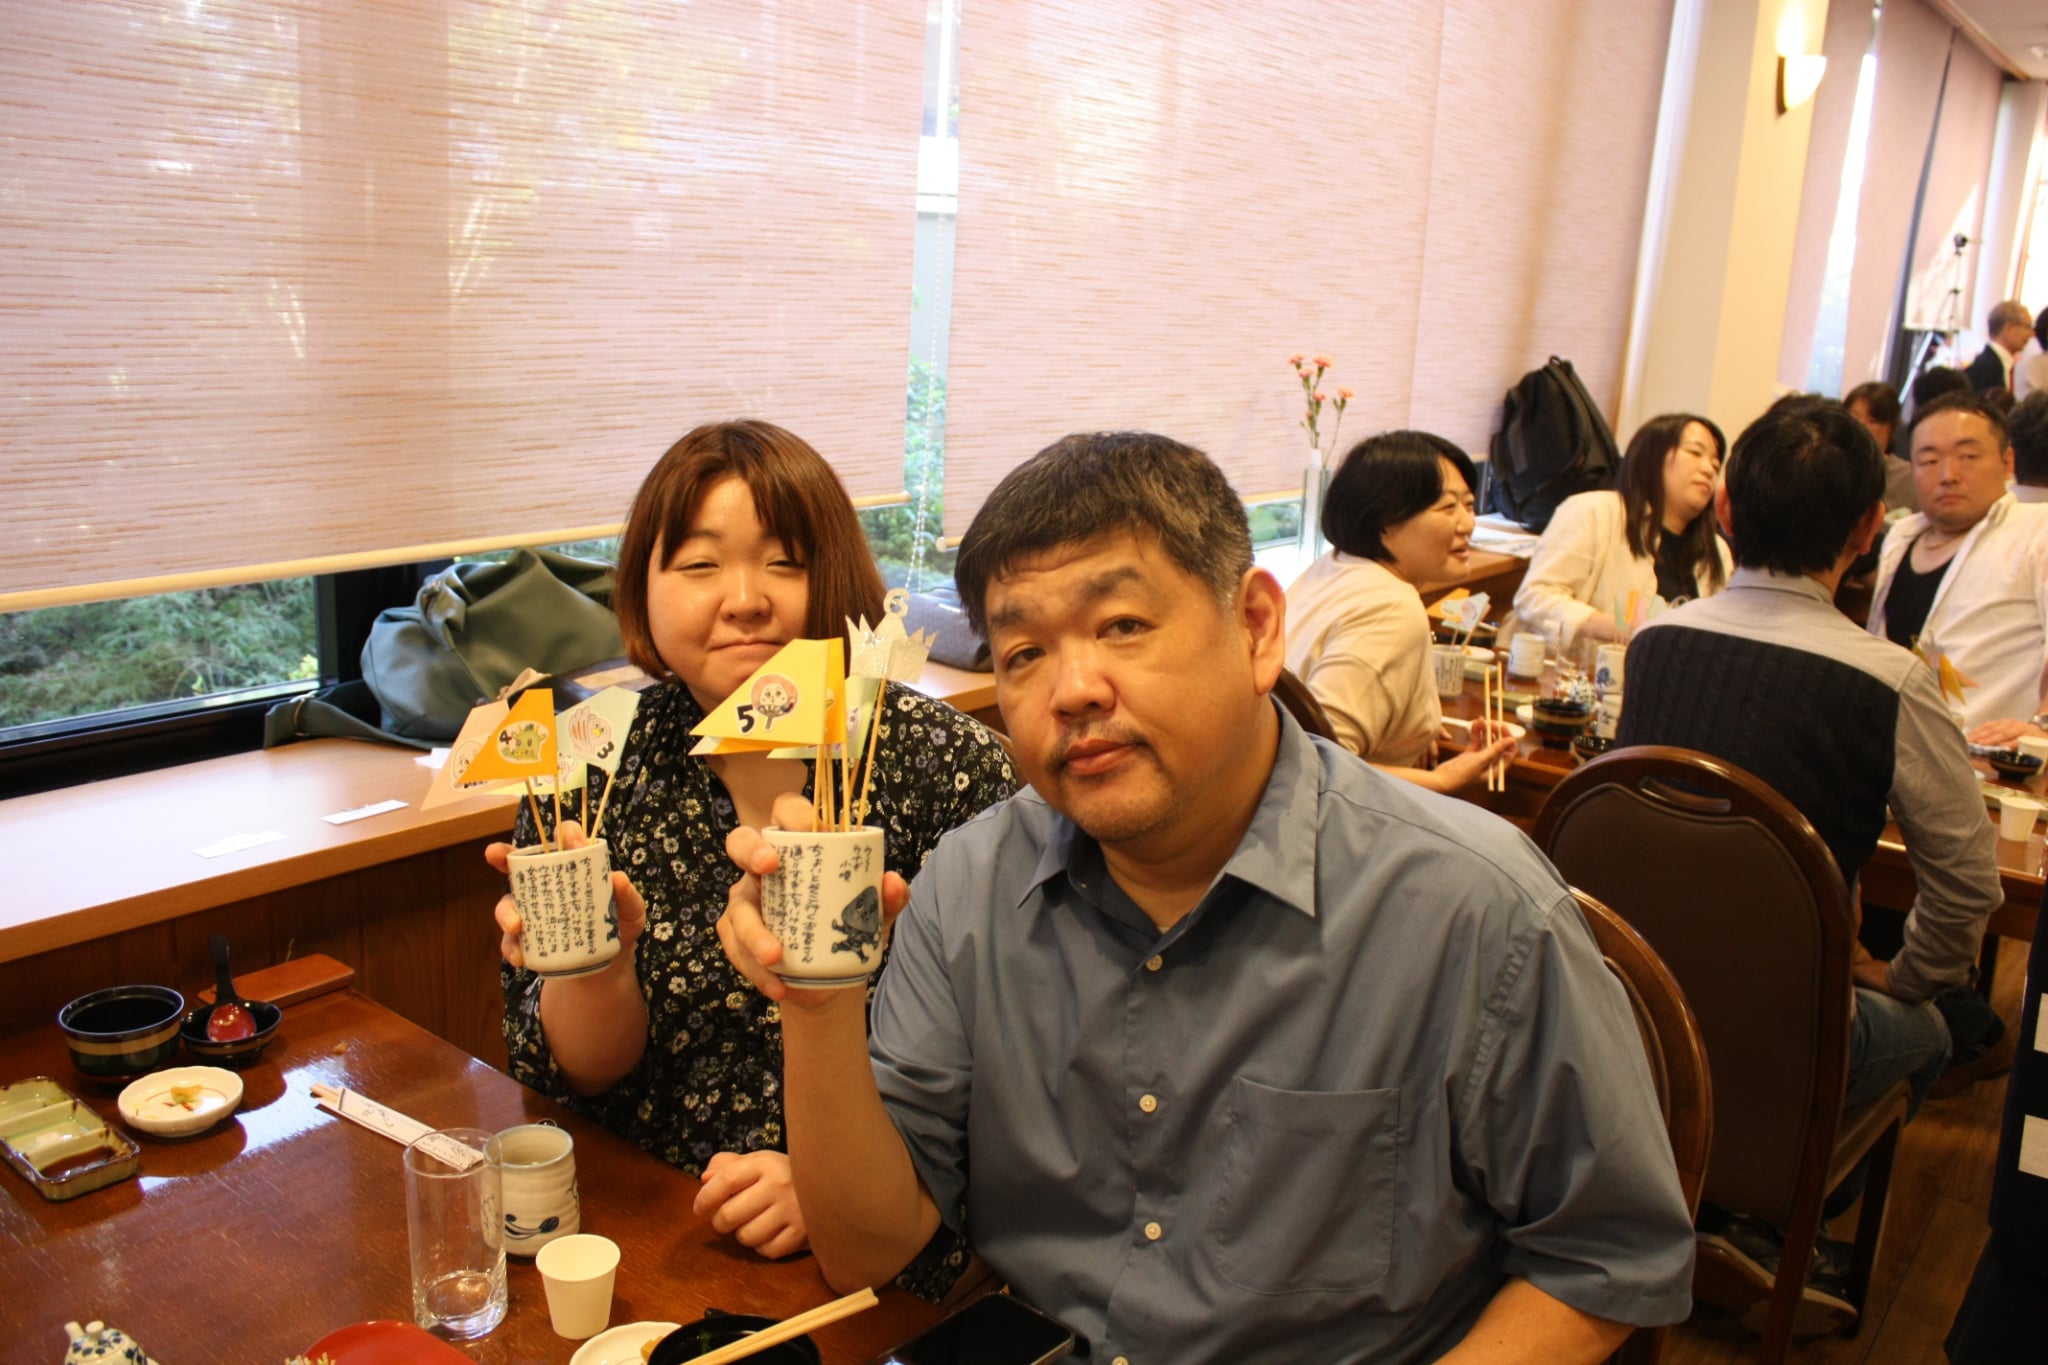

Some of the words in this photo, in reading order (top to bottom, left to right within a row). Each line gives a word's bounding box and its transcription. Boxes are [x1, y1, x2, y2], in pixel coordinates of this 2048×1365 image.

[736, 705, 755, 733] 5
[499, 732, 513, 745] 4
[597, 741, 615, 759] 3
